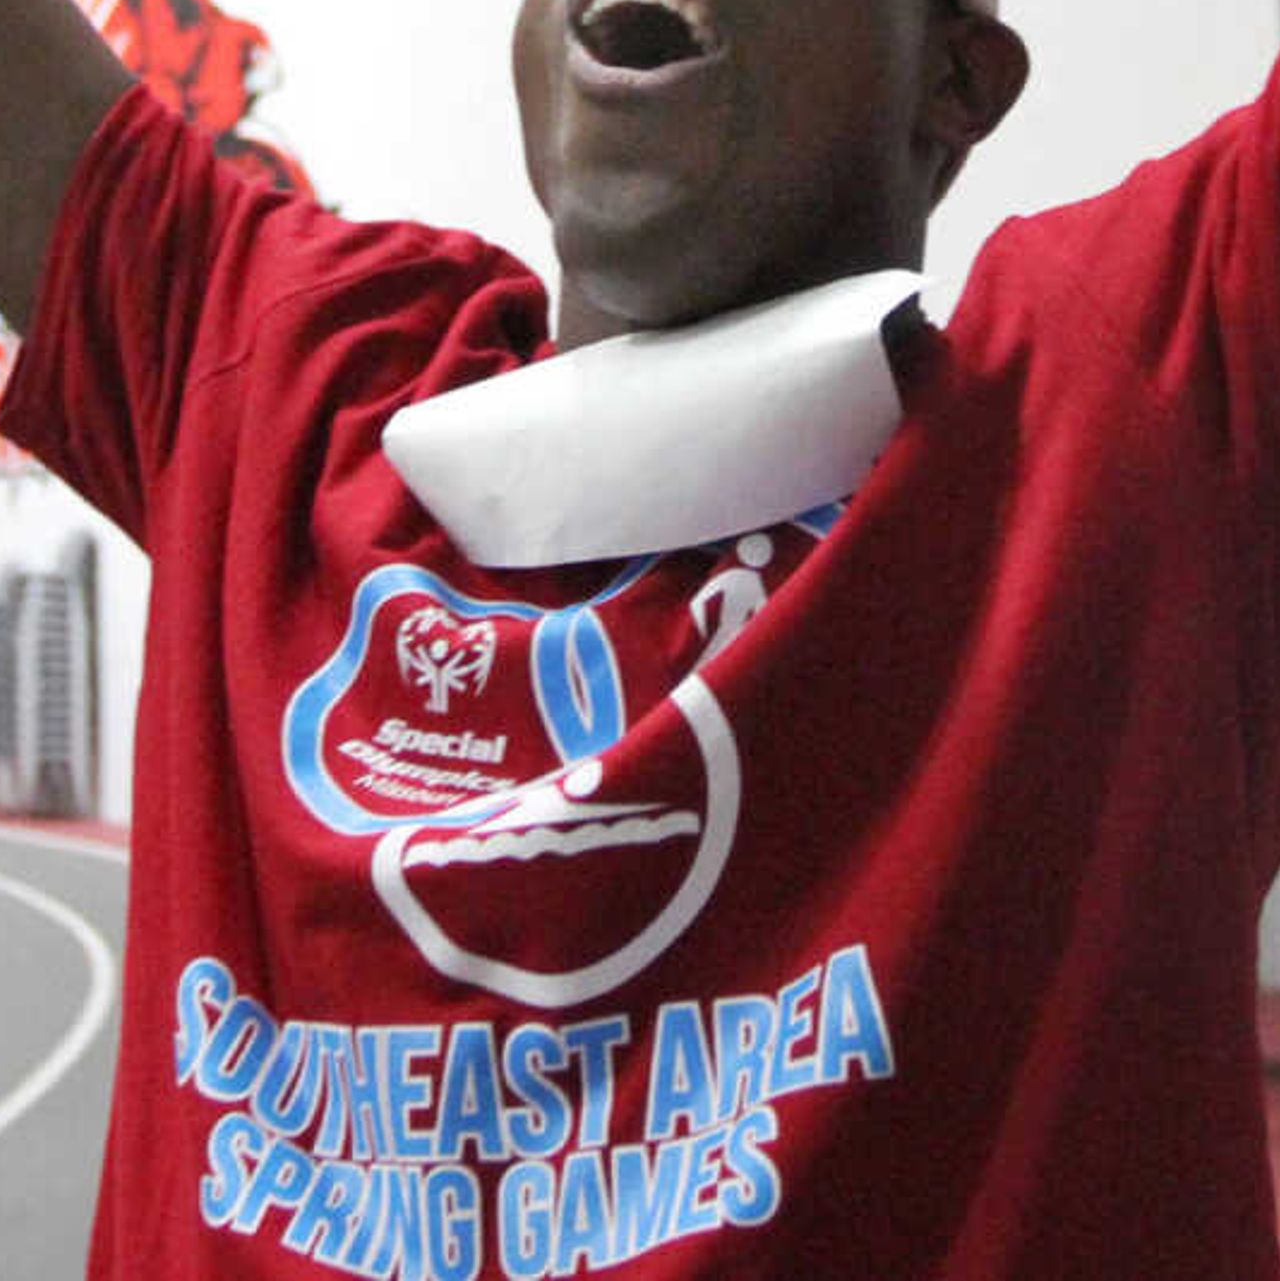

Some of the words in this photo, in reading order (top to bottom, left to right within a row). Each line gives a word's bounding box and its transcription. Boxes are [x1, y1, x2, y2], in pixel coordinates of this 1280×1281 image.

[372, 717, 508, 765] Special
[175, 956, 630, 1163] SOUTHEAST
[644, 943, 895, 1141] AREA
[199, 1110, 482, 1281] SPRING
[497, 1104, 781, 1280] GAMES
